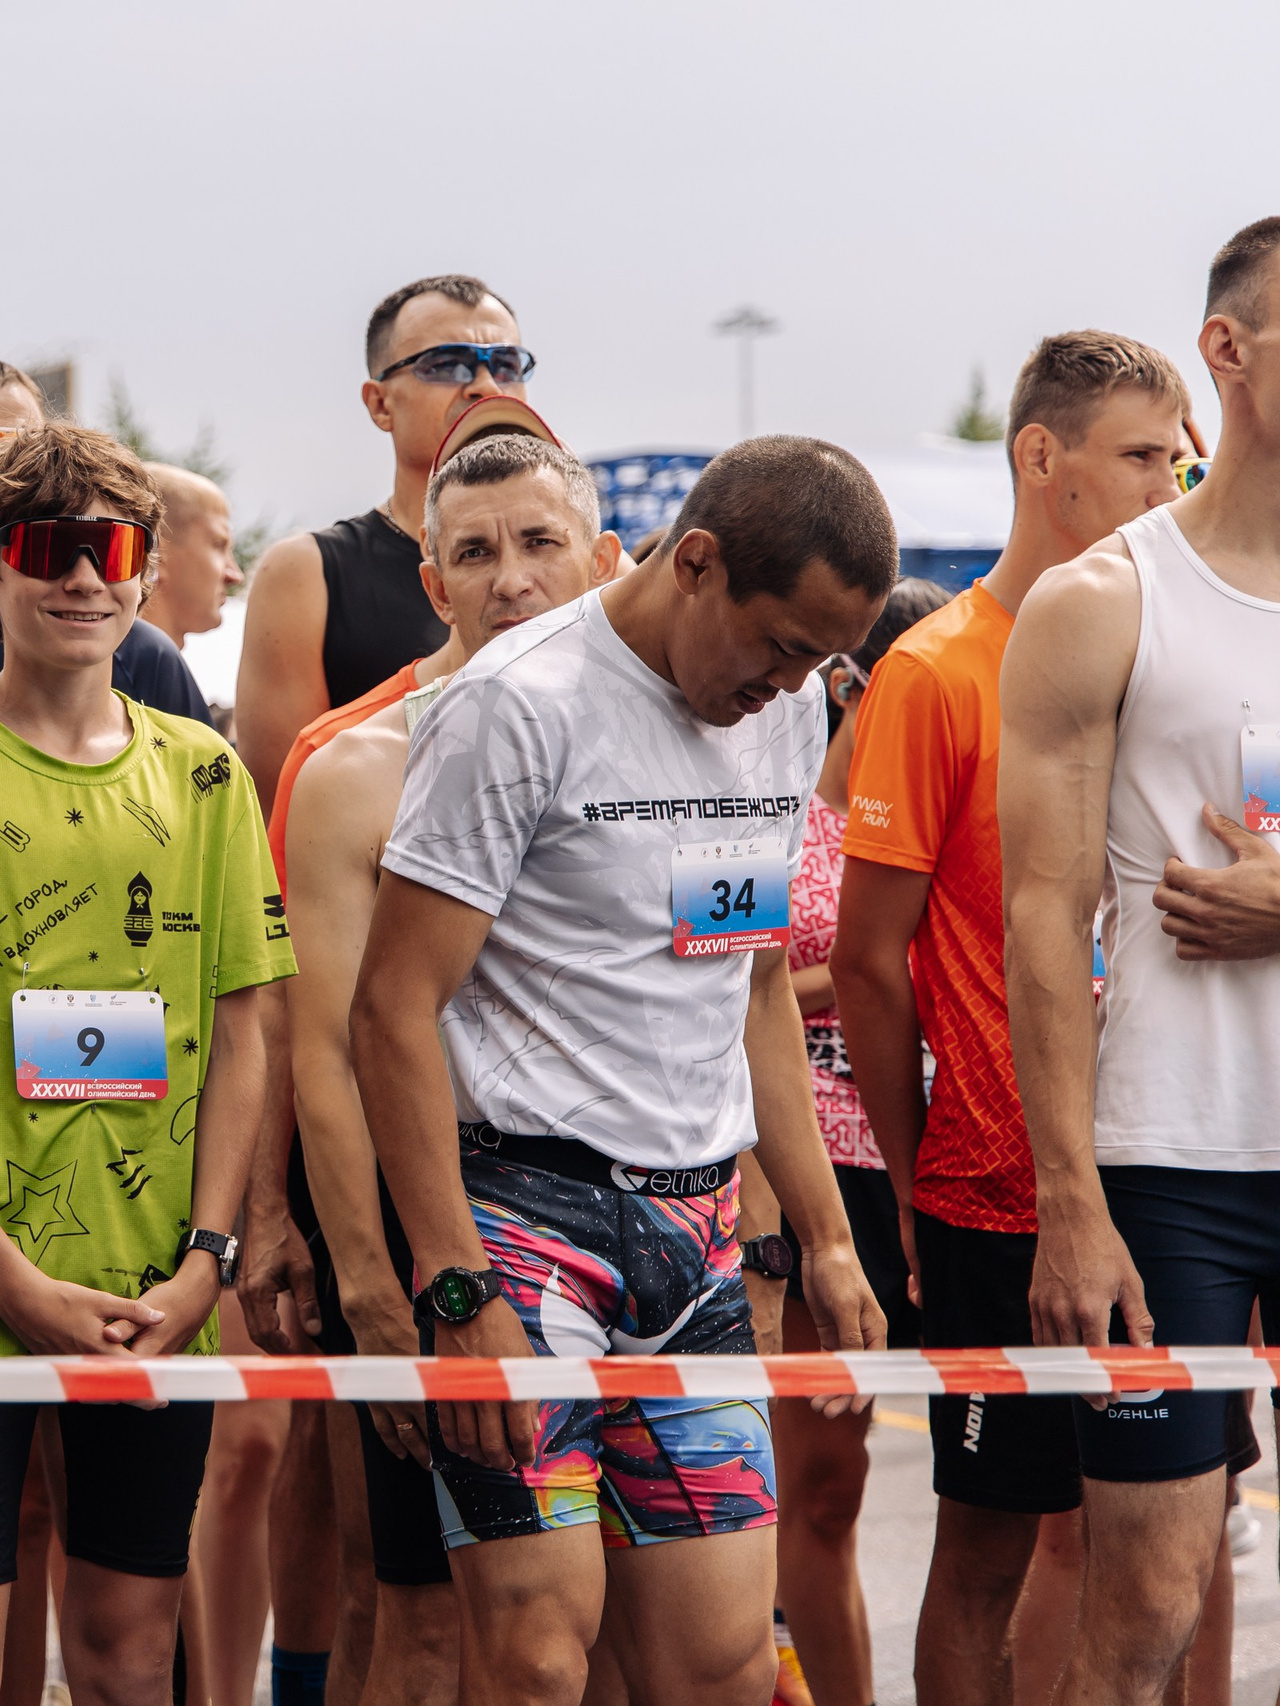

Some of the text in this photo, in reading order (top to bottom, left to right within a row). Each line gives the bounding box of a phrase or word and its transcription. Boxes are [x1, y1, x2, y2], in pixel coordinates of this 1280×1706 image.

[861, 812, 890, 829] RUN
[709, 878, 756, 922] 34
[3, 883, 98, 960] ВДОХНОВЛЯЕТ
[684, 938, 729, 956] XXXVII
[76, 1027, 105, 1067] 9
[30, 1082, 142, 1097] XXXVII ВСЕРОССИЙСКИЙ
[87, 1089, 138, 1098] ОЛИМПИЙСКИЙ
[650, 1165, 720, 1194] ethika
